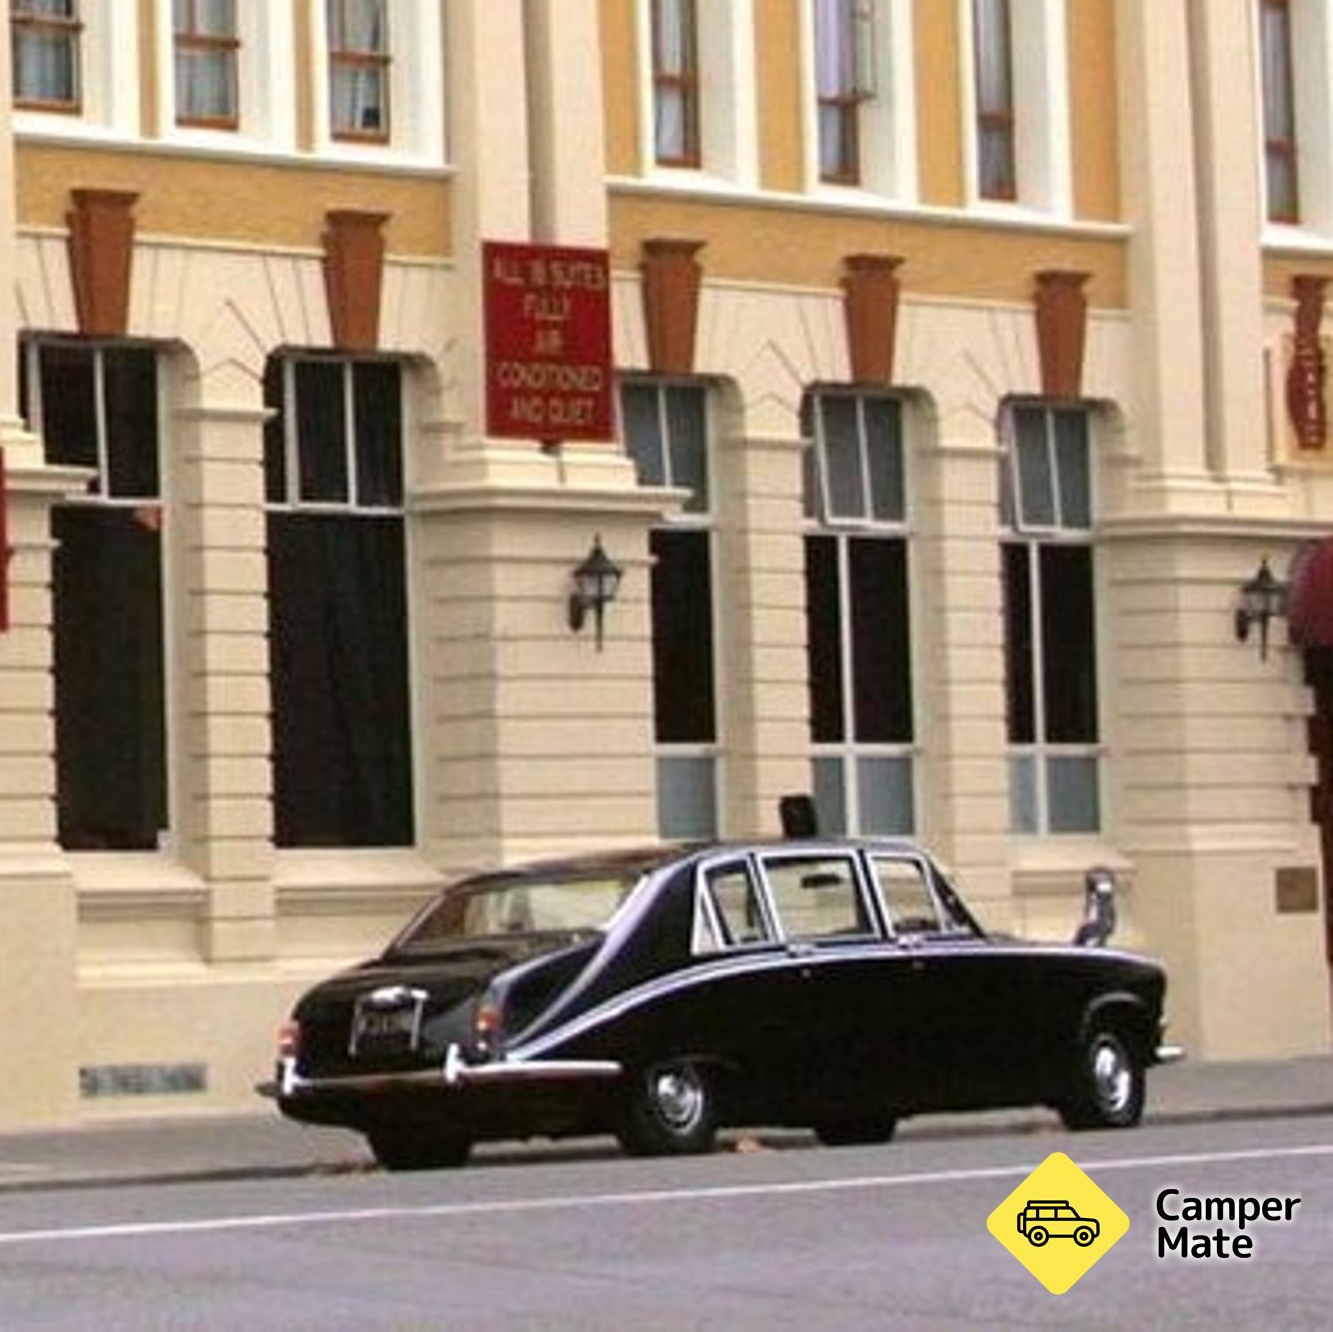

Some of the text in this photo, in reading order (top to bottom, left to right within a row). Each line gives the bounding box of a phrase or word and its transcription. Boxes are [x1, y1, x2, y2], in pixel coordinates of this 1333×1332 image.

[523, 294, 572, 321] FULLY
[497, 362, 603, 392] CONDITIONED
[508, 396, 544, 423] AND
